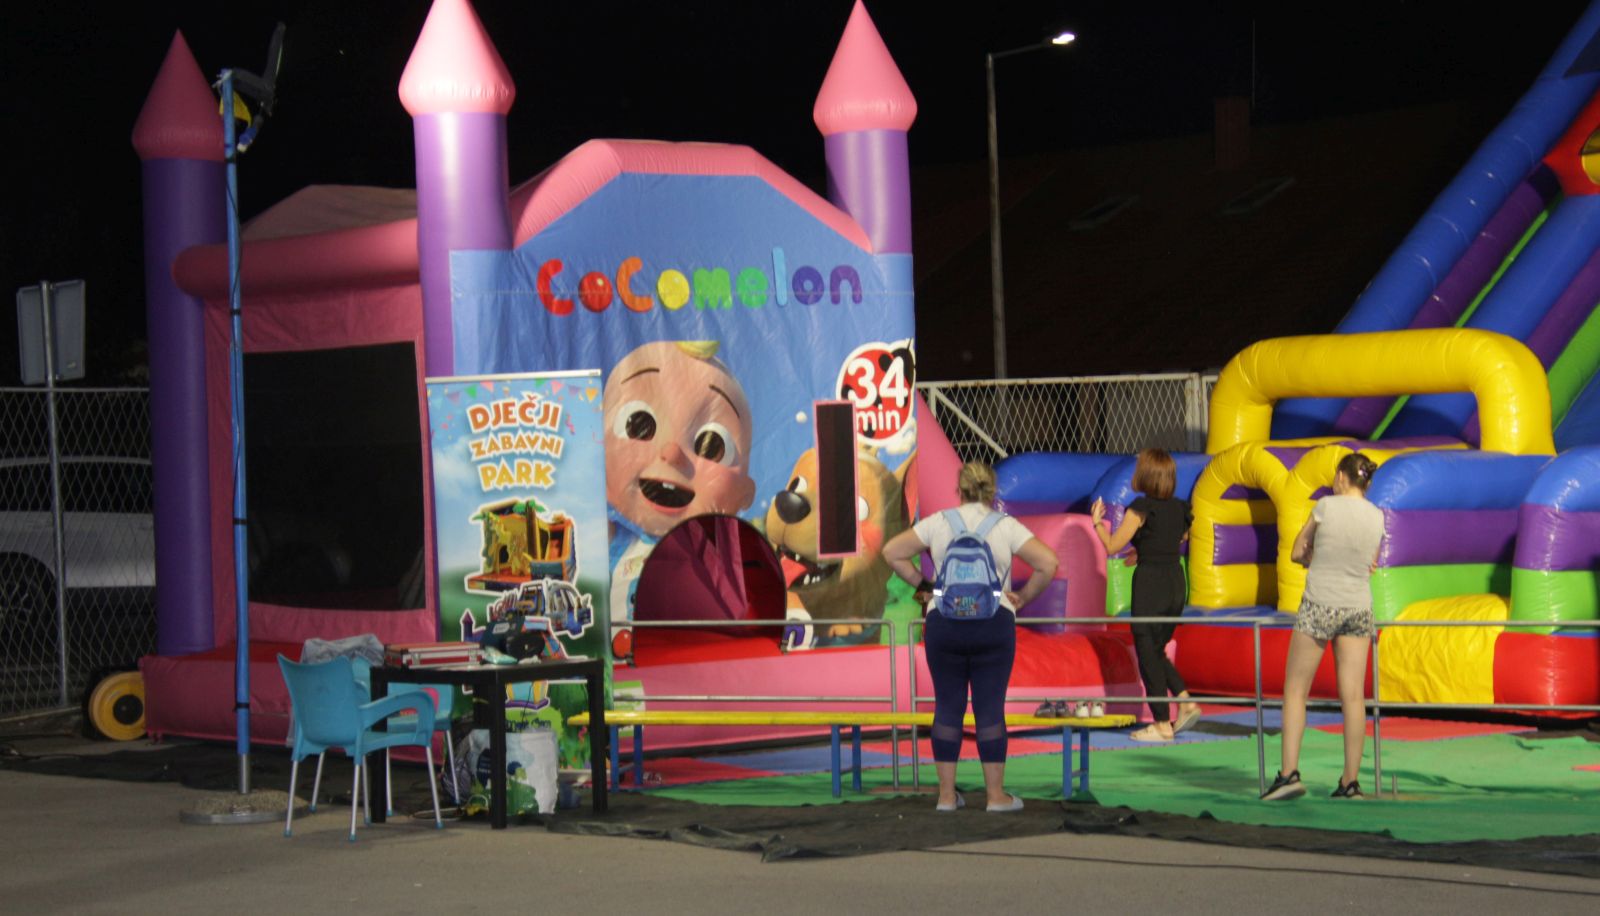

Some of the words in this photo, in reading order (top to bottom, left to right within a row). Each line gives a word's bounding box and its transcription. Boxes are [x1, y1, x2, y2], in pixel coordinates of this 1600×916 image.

[847, 355, 909, 409] 34
[467, 392, 561, 432] DJEČJI
[856, 403, 900, 432] min
[471, 433, 563, 458] ZABAVNI
[479, 459, 554, 489] PARK
